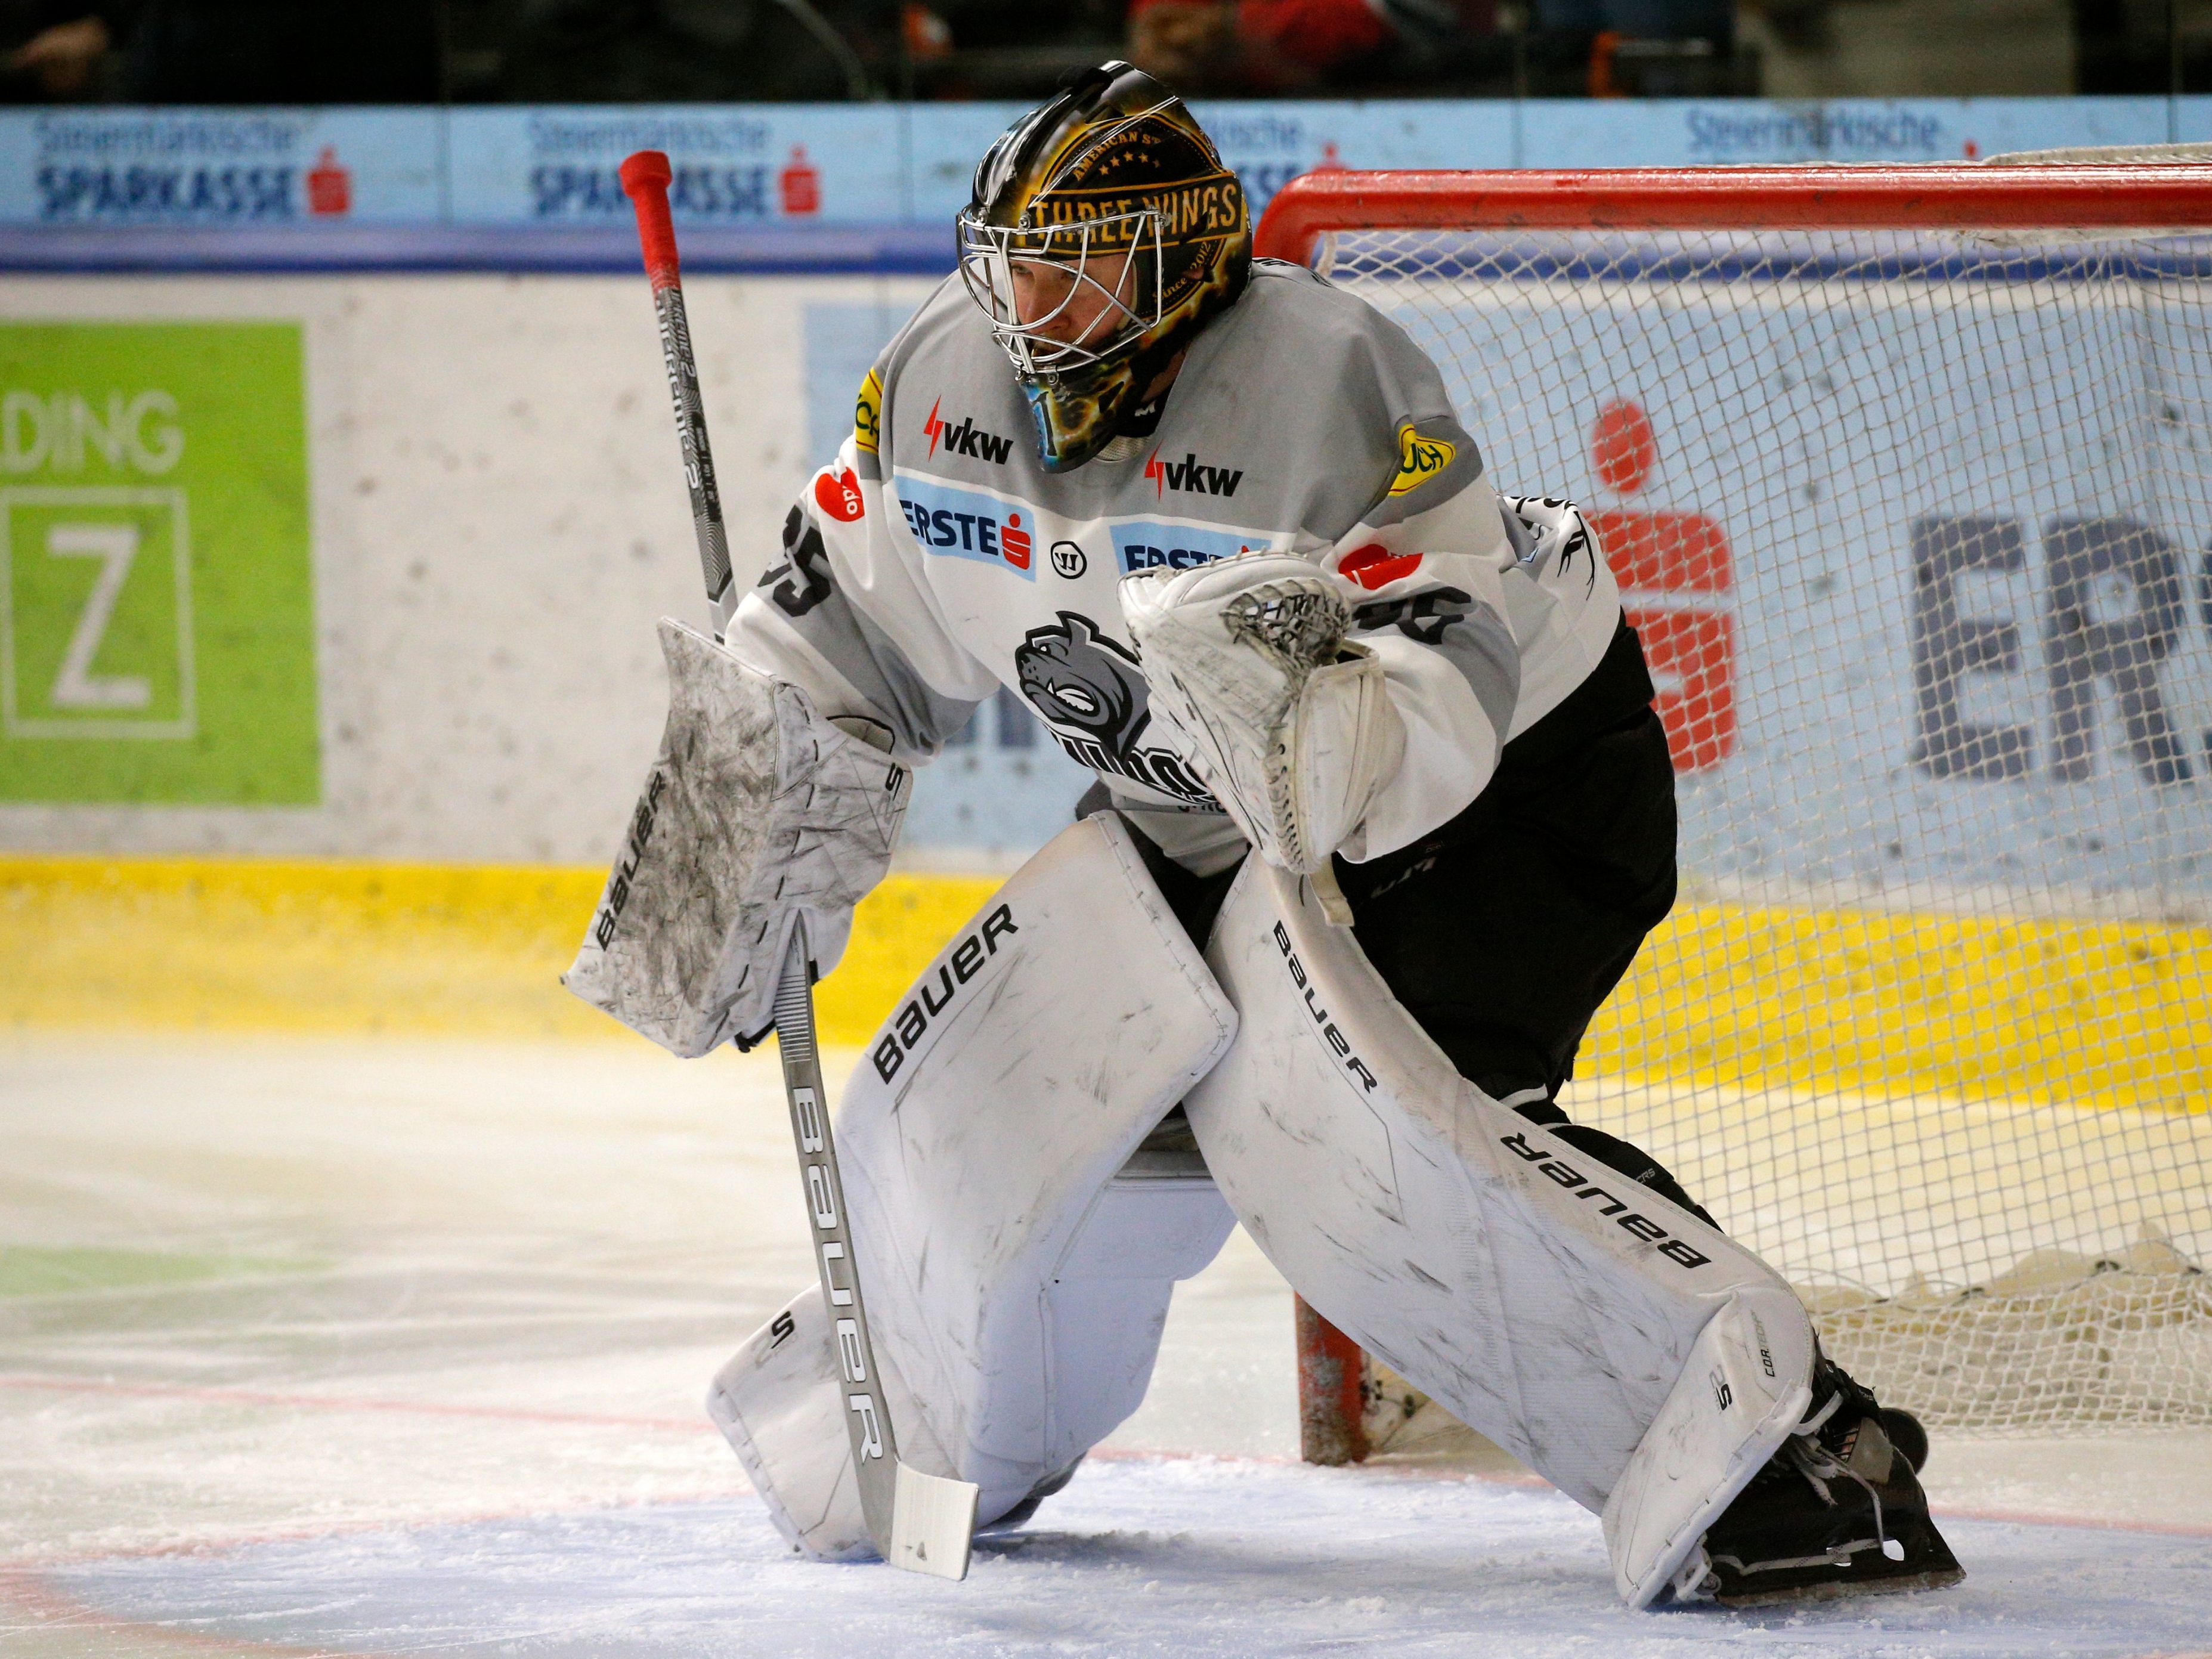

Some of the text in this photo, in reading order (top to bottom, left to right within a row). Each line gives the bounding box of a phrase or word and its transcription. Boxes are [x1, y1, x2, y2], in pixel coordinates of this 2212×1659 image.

[1035, 200, 1133, 243] THREE
[1142, 183, 1237, 237] WINGS
[1074, 131, 1138, 181] AMERICAN
[943, 417, 1014, 465] vkw
[1164, 453, 1243, 497] vkw
[899, 500, 999, 556] ERSTE
[49, 525, 149, 707] Z
[1907, 514, 2212, 782] ER
[596, 770, 666, 952] BAUER
[873, 903, 1019, 1085] BAUER
[1273, 920, 1378, 1094] BAUER
[793, 1087, 885, 1465] BAUER
[1500, 1132, 1712, 1269] BAUER
